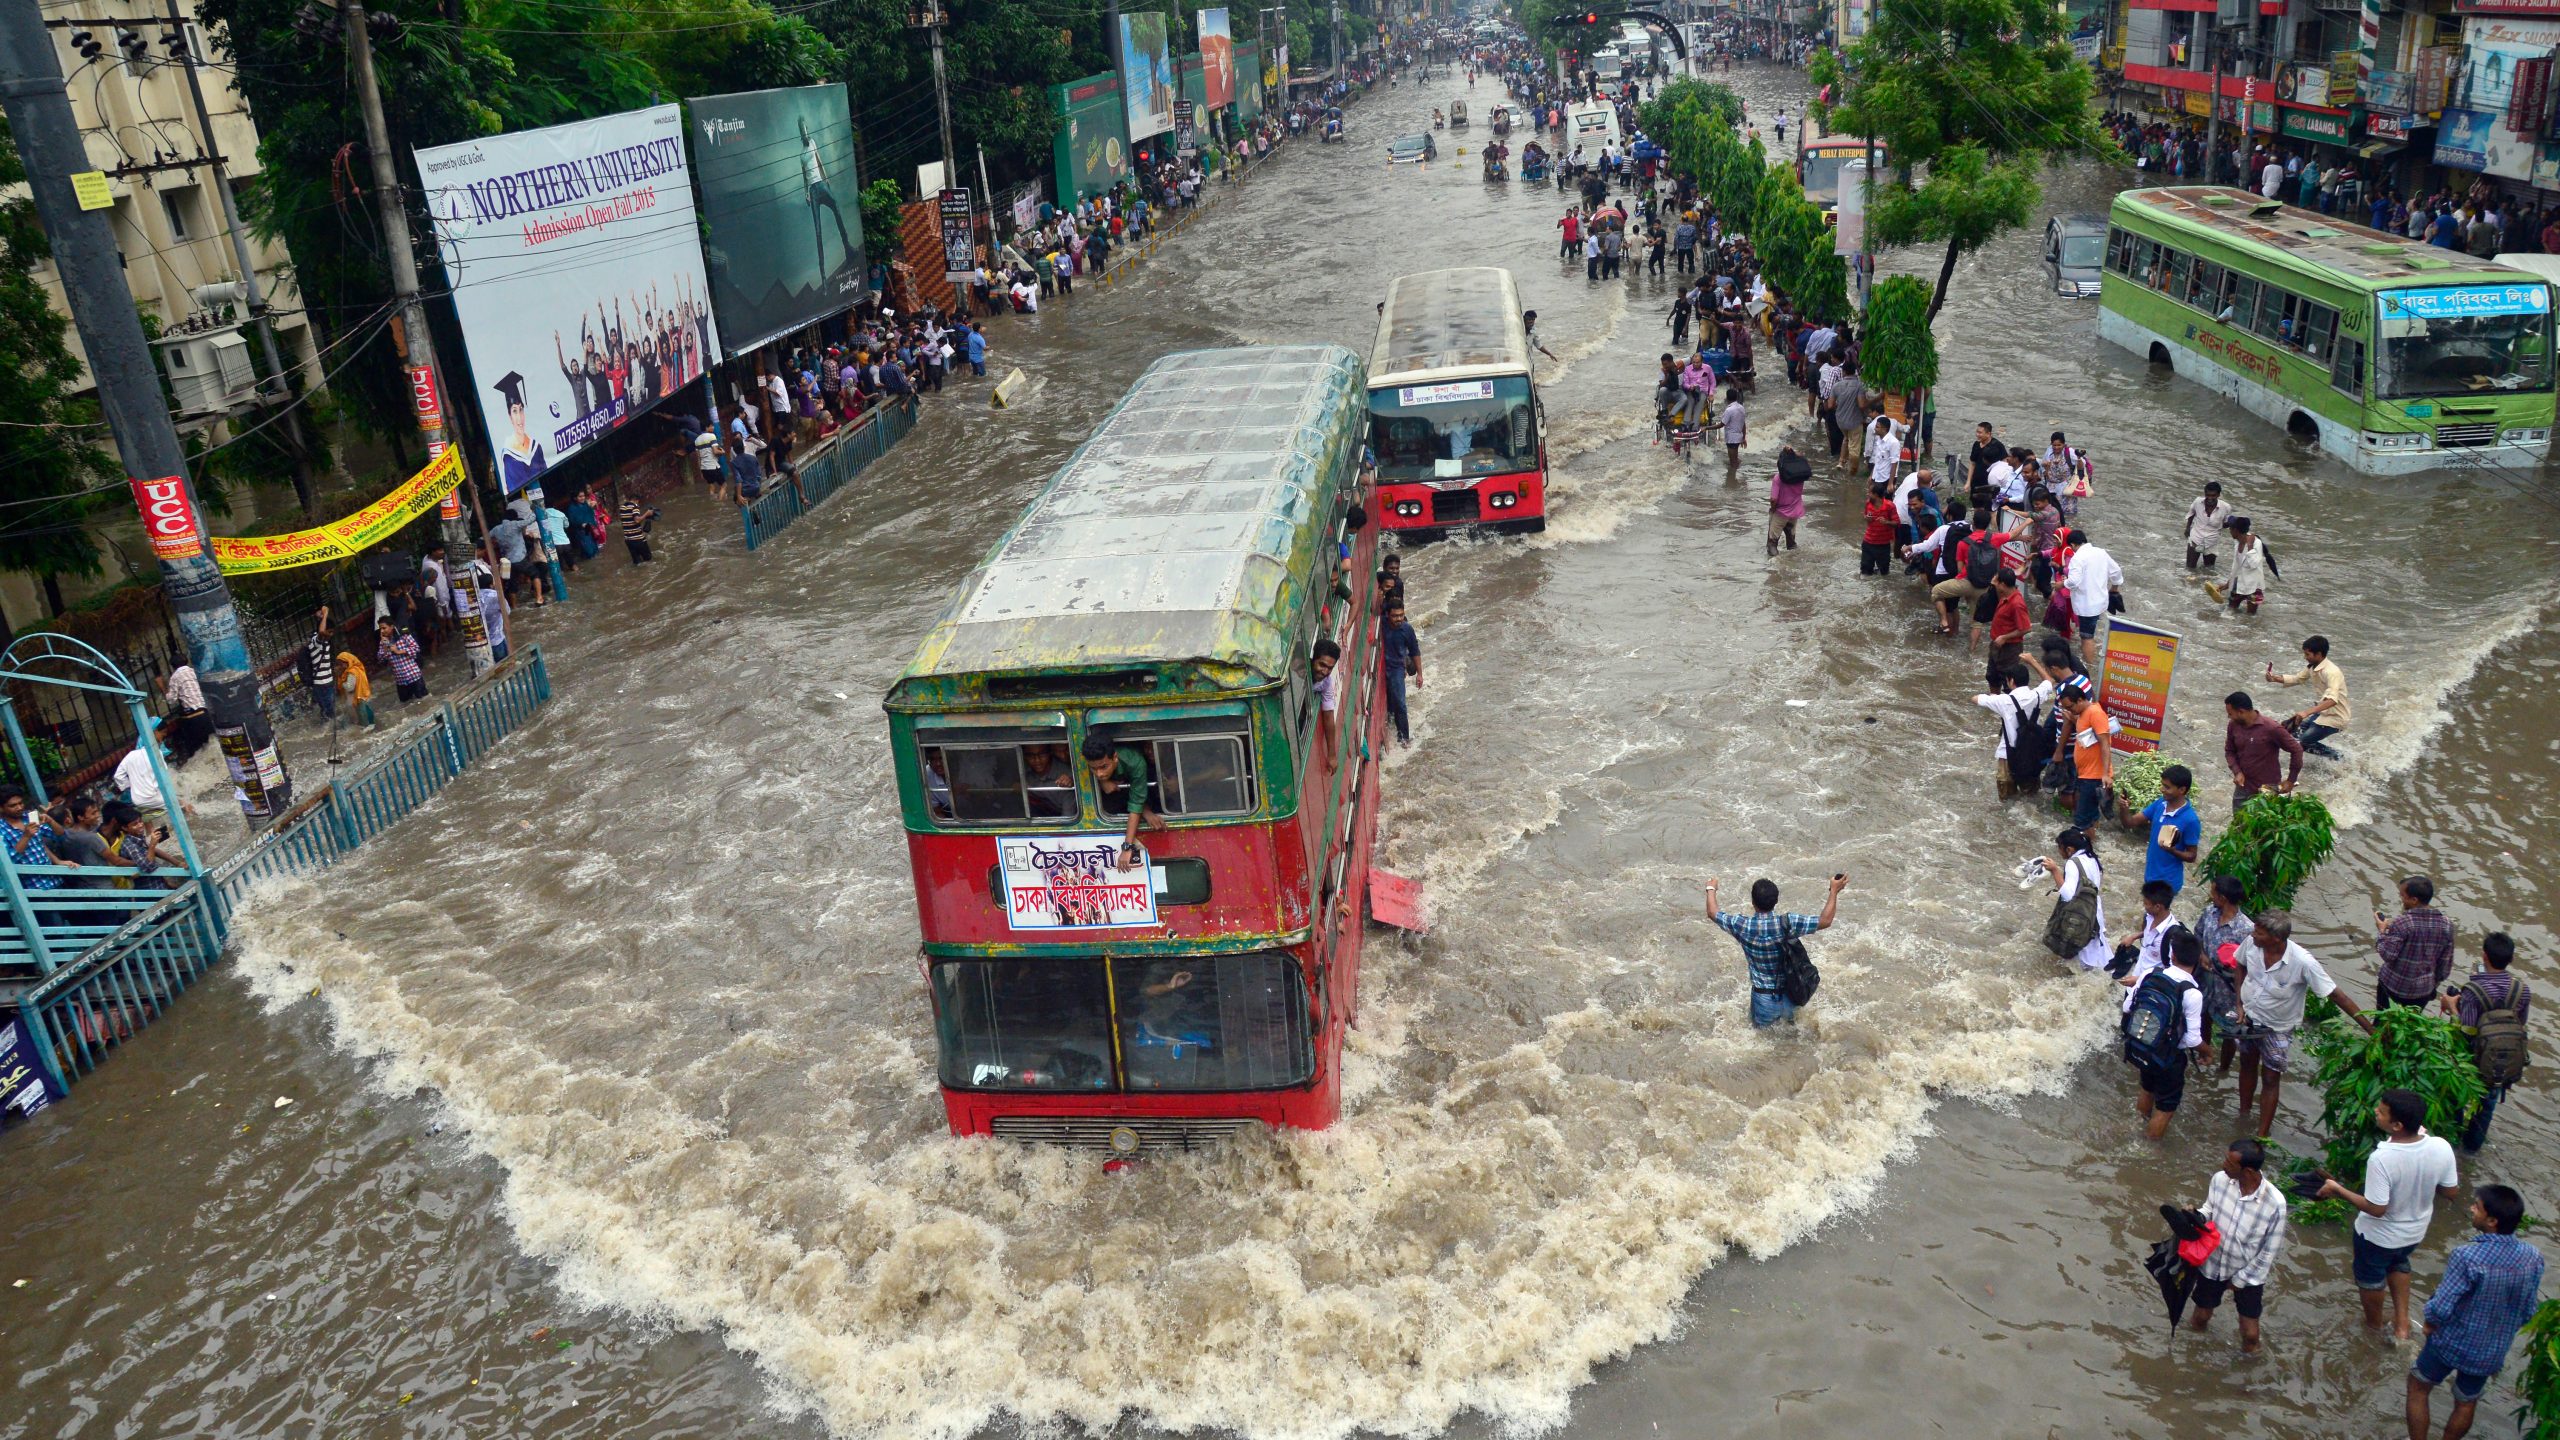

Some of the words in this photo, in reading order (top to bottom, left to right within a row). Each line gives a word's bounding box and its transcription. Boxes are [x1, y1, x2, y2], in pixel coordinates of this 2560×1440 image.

[2307, 118, 2336, 135] LABANGA
[1819, 149, 1837, 159] MERAZ
[1838, 148, 1867, 158] ENTERPRI
[427, 160, 451, 175] Approved
[457, 156, 469, 168] UGC
[467, 160, 591, 226] NORTHERN
[587, 136, 683, 193] UNIVERSITY
[522, 209, 585, 248] Admission
[585, 201, 615, 228] Open
[614, 196, 633, 219] Fall
[635, 186, 655, 211] 2015
[2402, 295, 2437, 308] বাহন
[2444, 290, 2500, 306] পরিবহন
[412, 370, 434, 411] UCC
[144, 481, 189, 534] UCC
[2112, 651, 2125, 660] OUR
[2124, 654, 2149, 664] SERVICES
[2110, 660, 2133, 672] Weight
[2134, 666, 2148, 675] loss
[2110, 672, 2125, 684] Body
[2126, 677, 2153, 690] Shaping
[2109, 684, 2123, 695] Gym
[2123, 688, 2148, 701] Facility
[2108, 696, 2121, 706] Diet
[2122, 700, 2157, 715] Counseling
[2107, 706, 2128, 718] Physio
[2129, 711, 2155, 725] Therapy
[1029, 841, 1120, 870] চৈতালী
[1012, 886, 1049, 914] ঢাকা
[1052, 874, 1147, 921] বিশ্ববিদ্যালয়
